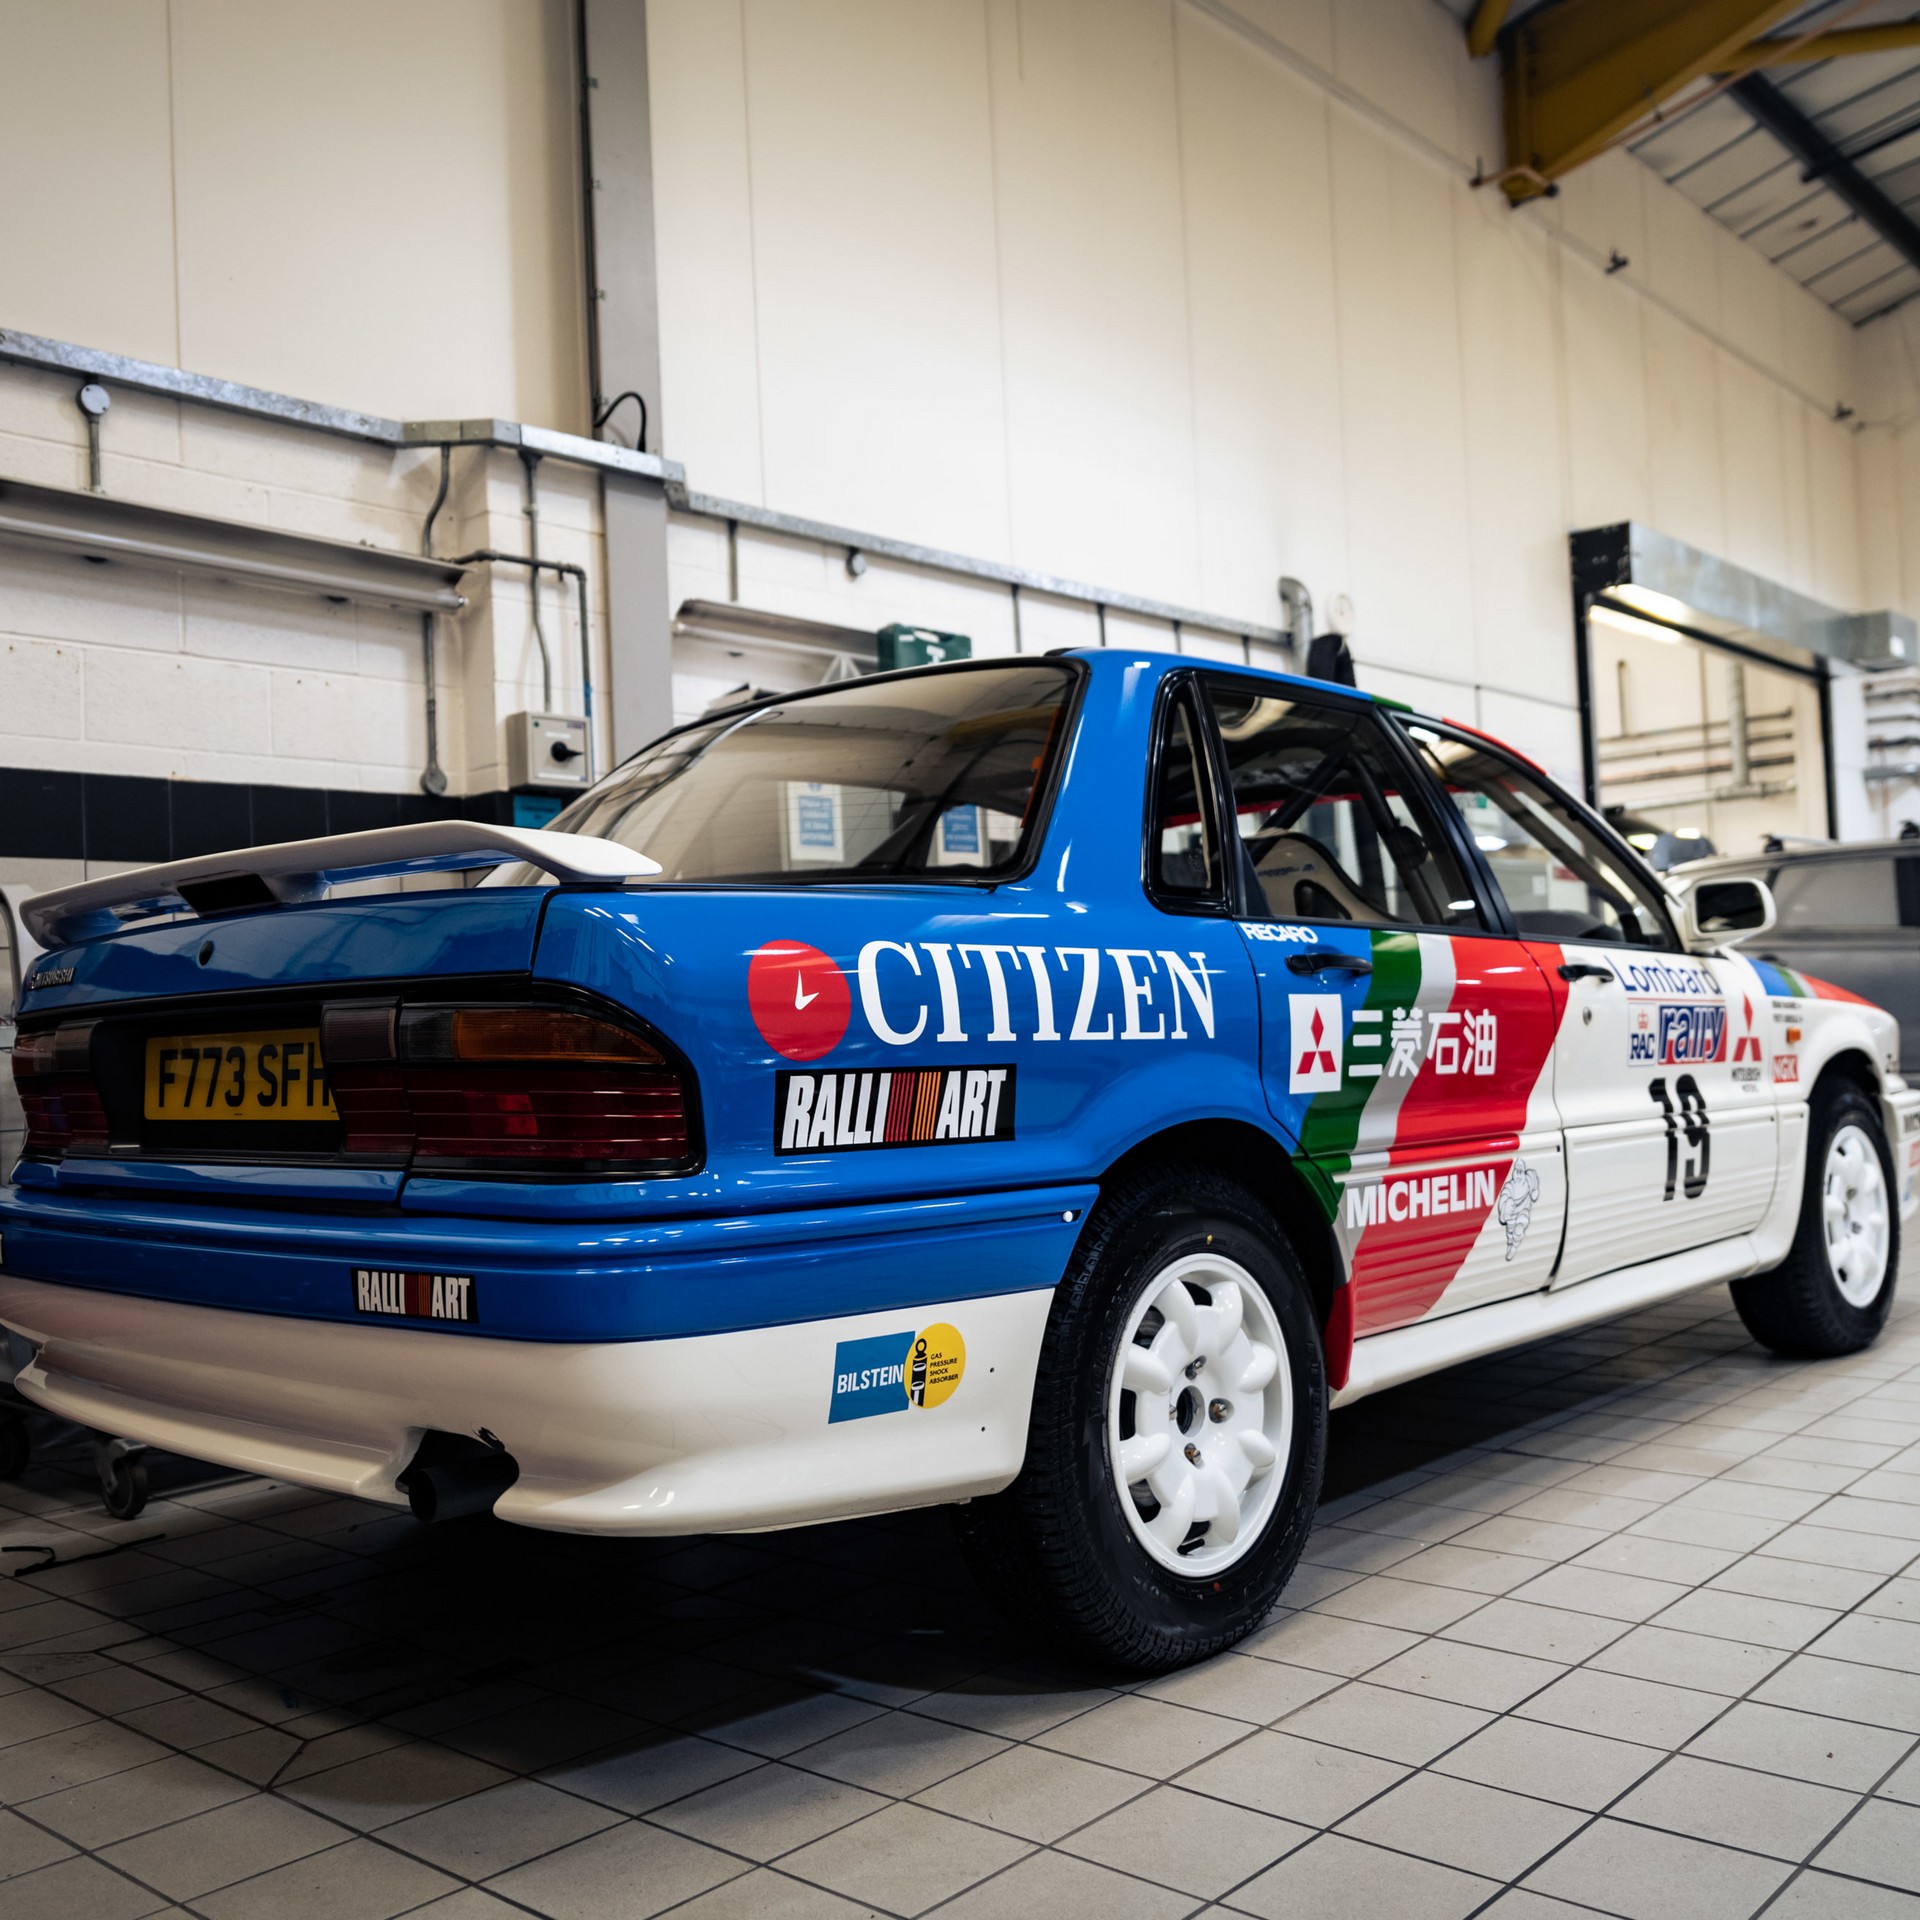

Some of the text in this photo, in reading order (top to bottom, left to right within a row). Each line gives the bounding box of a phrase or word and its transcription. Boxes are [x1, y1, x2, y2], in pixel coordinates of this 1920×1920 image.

[1239, 922, 1318, 944] RECARO
[857, 940, 1215, 1045] CITIZEN
[1604, 954, 1722, 995] Lombard
[1348, 1007, 1497, 1077] 三菱石油
[1630, 1033, 1655, 1060] RAC
[1660, 1008, 1725, 1063] rally
[158, 1042, 331, 1108] F773 SFH
[1774, 1057, 1798, 1081] NGK
[781, 1069, 1007, 1149] RALLI ART
[1648, 1074, 1710, 1201] 19
[1346, 1169, 1495, 1229] MICHELIN
[357, 1270, 470, 1320] RALLI ART
[929, 1358, 958, 1368] PRESSURE
[929, 1368, 949, 1377] SHOCK
[930, 1352, 943, 1360] GAS
[836, 1364, 905, 1394] BILSTEIN
[929, 1374, 959, 1385] ABSORBER
